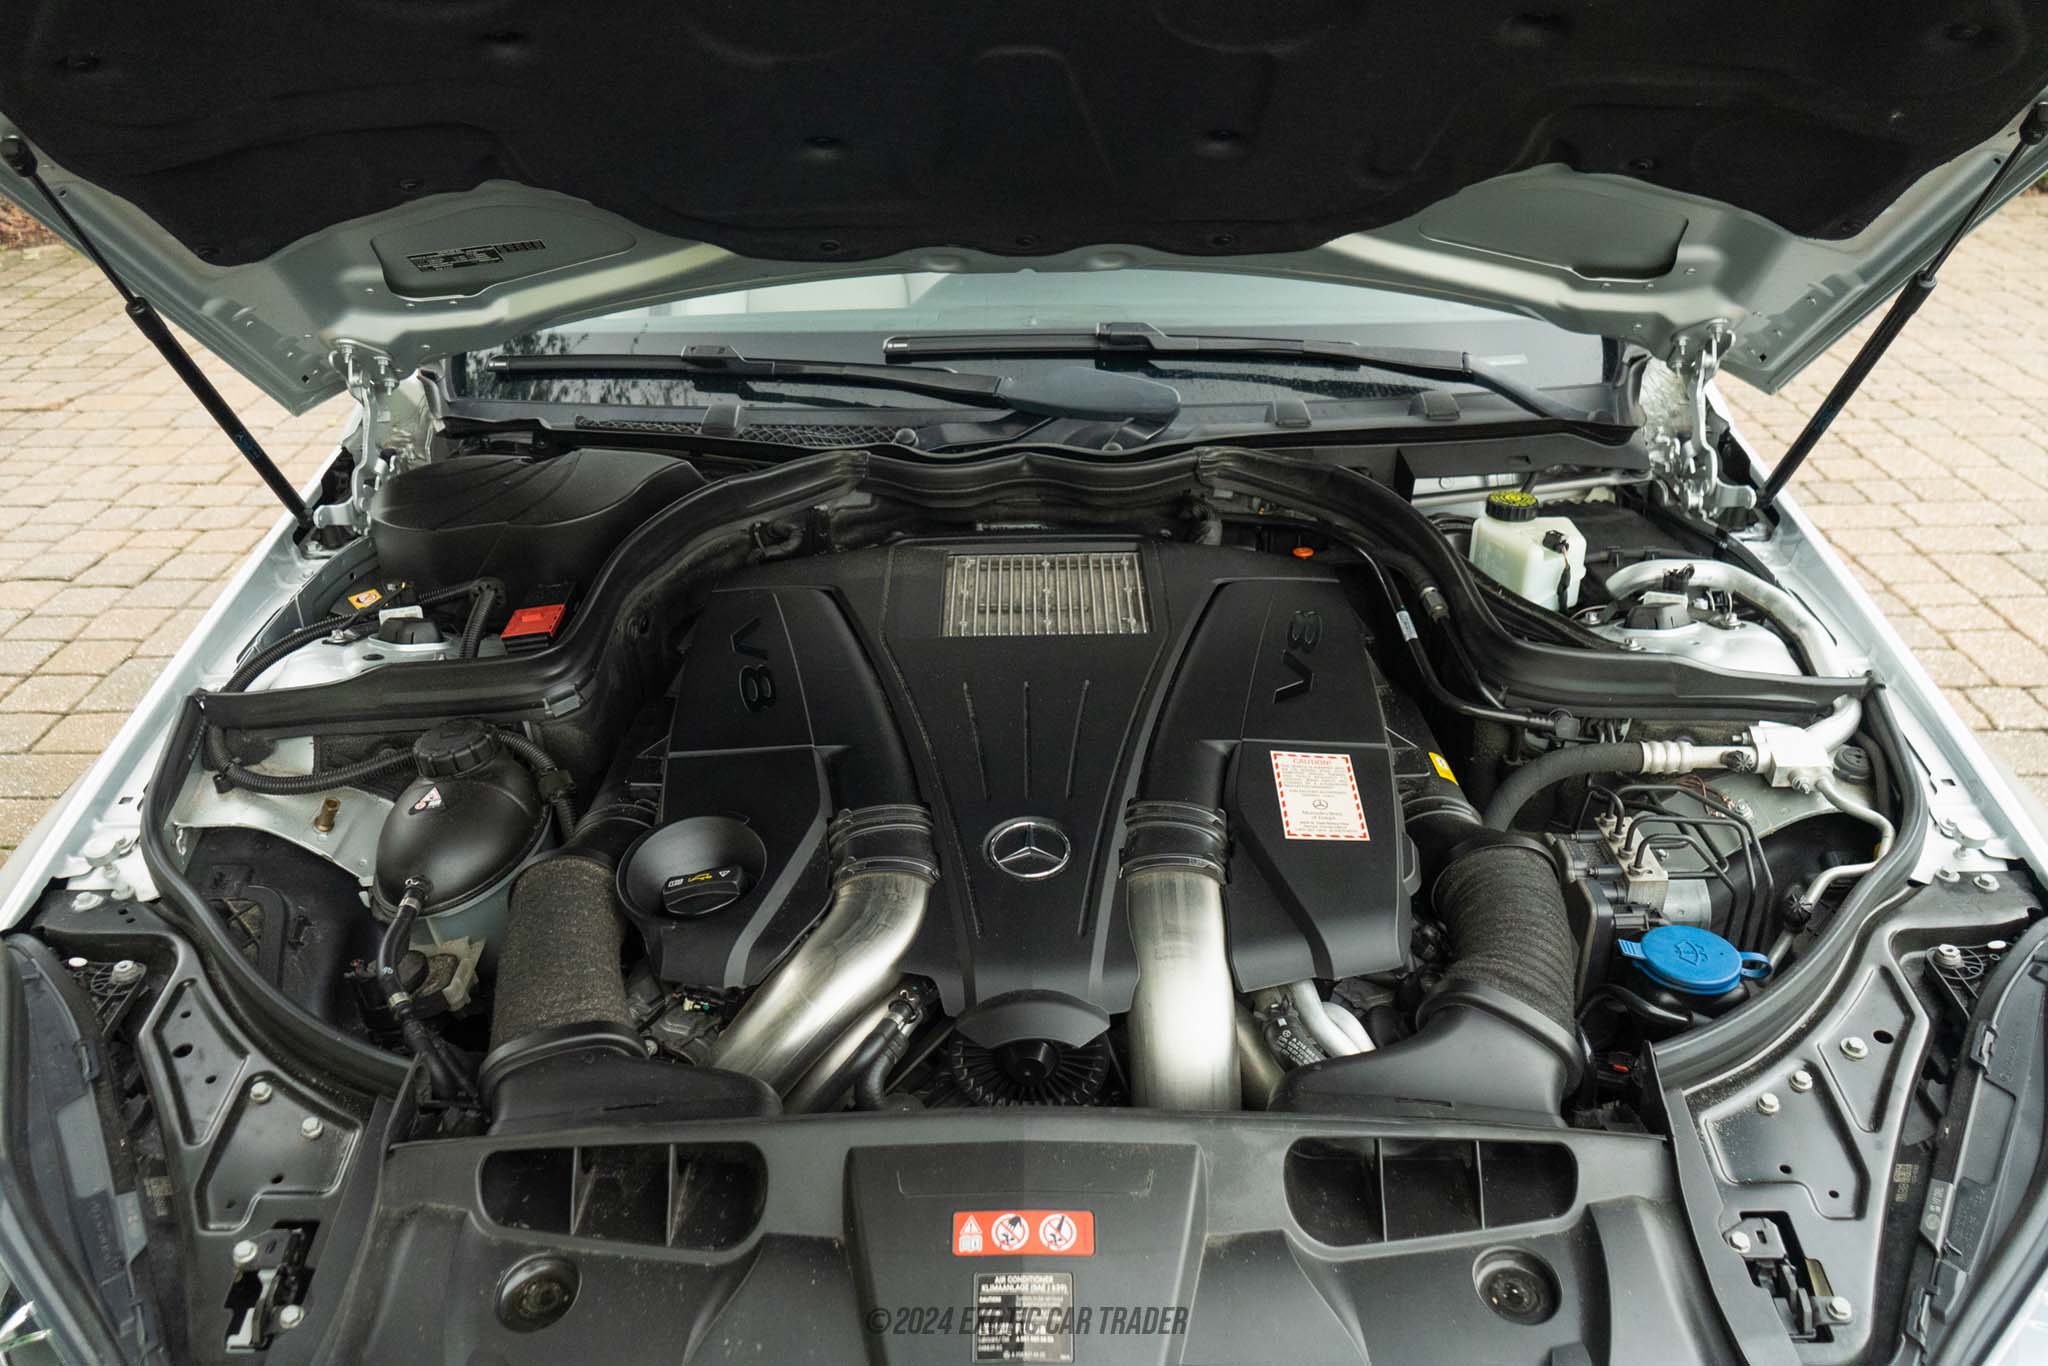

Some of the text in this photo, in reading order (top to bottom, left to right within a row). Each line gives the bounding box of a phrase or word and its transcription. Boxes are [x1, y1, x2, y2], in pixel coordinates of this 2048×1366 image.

[731, 616, 776, 711] V8
[1273, 610, 1322, 704] V8
[994, 1275, 1054, 1284] AIR CONDITIONER
